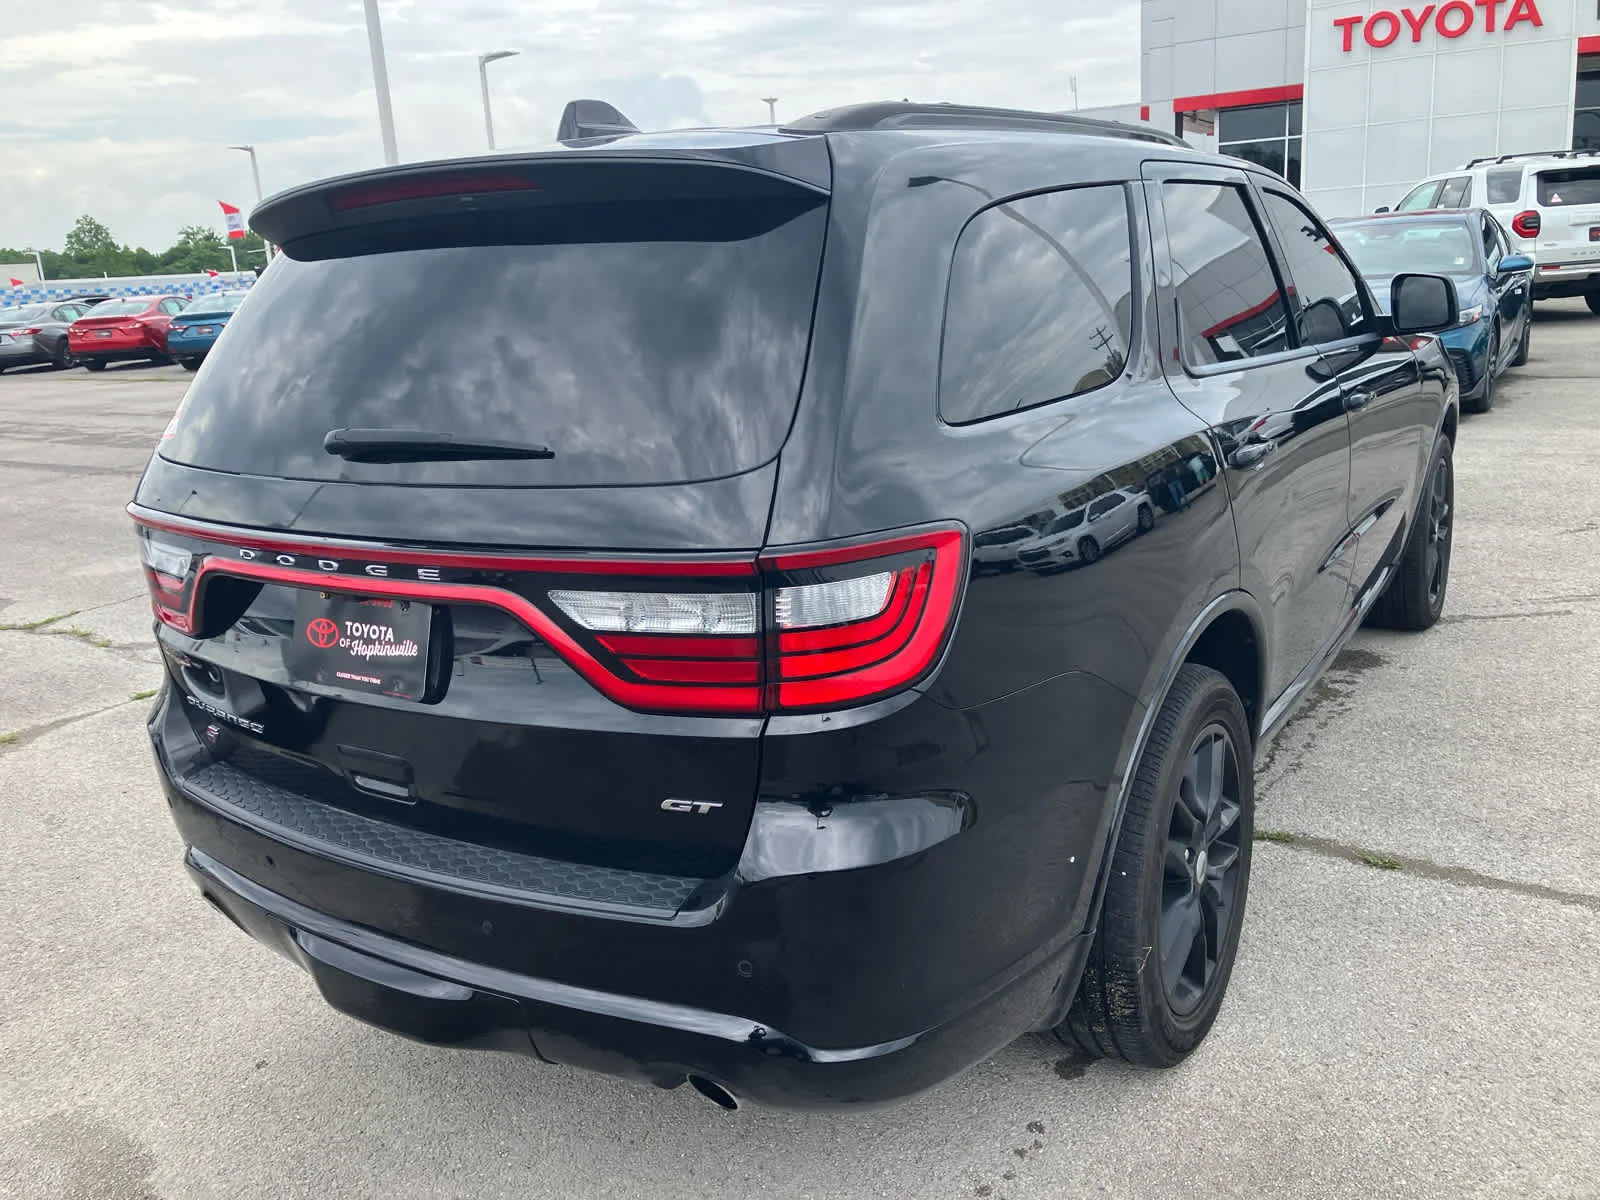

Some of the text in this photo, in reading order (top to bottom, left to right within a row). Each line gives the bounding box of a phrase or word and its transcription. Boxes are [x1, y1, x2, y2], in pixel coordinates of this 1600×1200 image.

[1333, 0, 1543, 52] TOYOTA
[239, 549, 441, 581] DODGE
[345, 621, 394, 642] TOYOTA
[339, 638, 418, 661] OF Hopkinsville
[186, 695, 265, 734] DURANGO
[660, 799, 724, 814] GT
